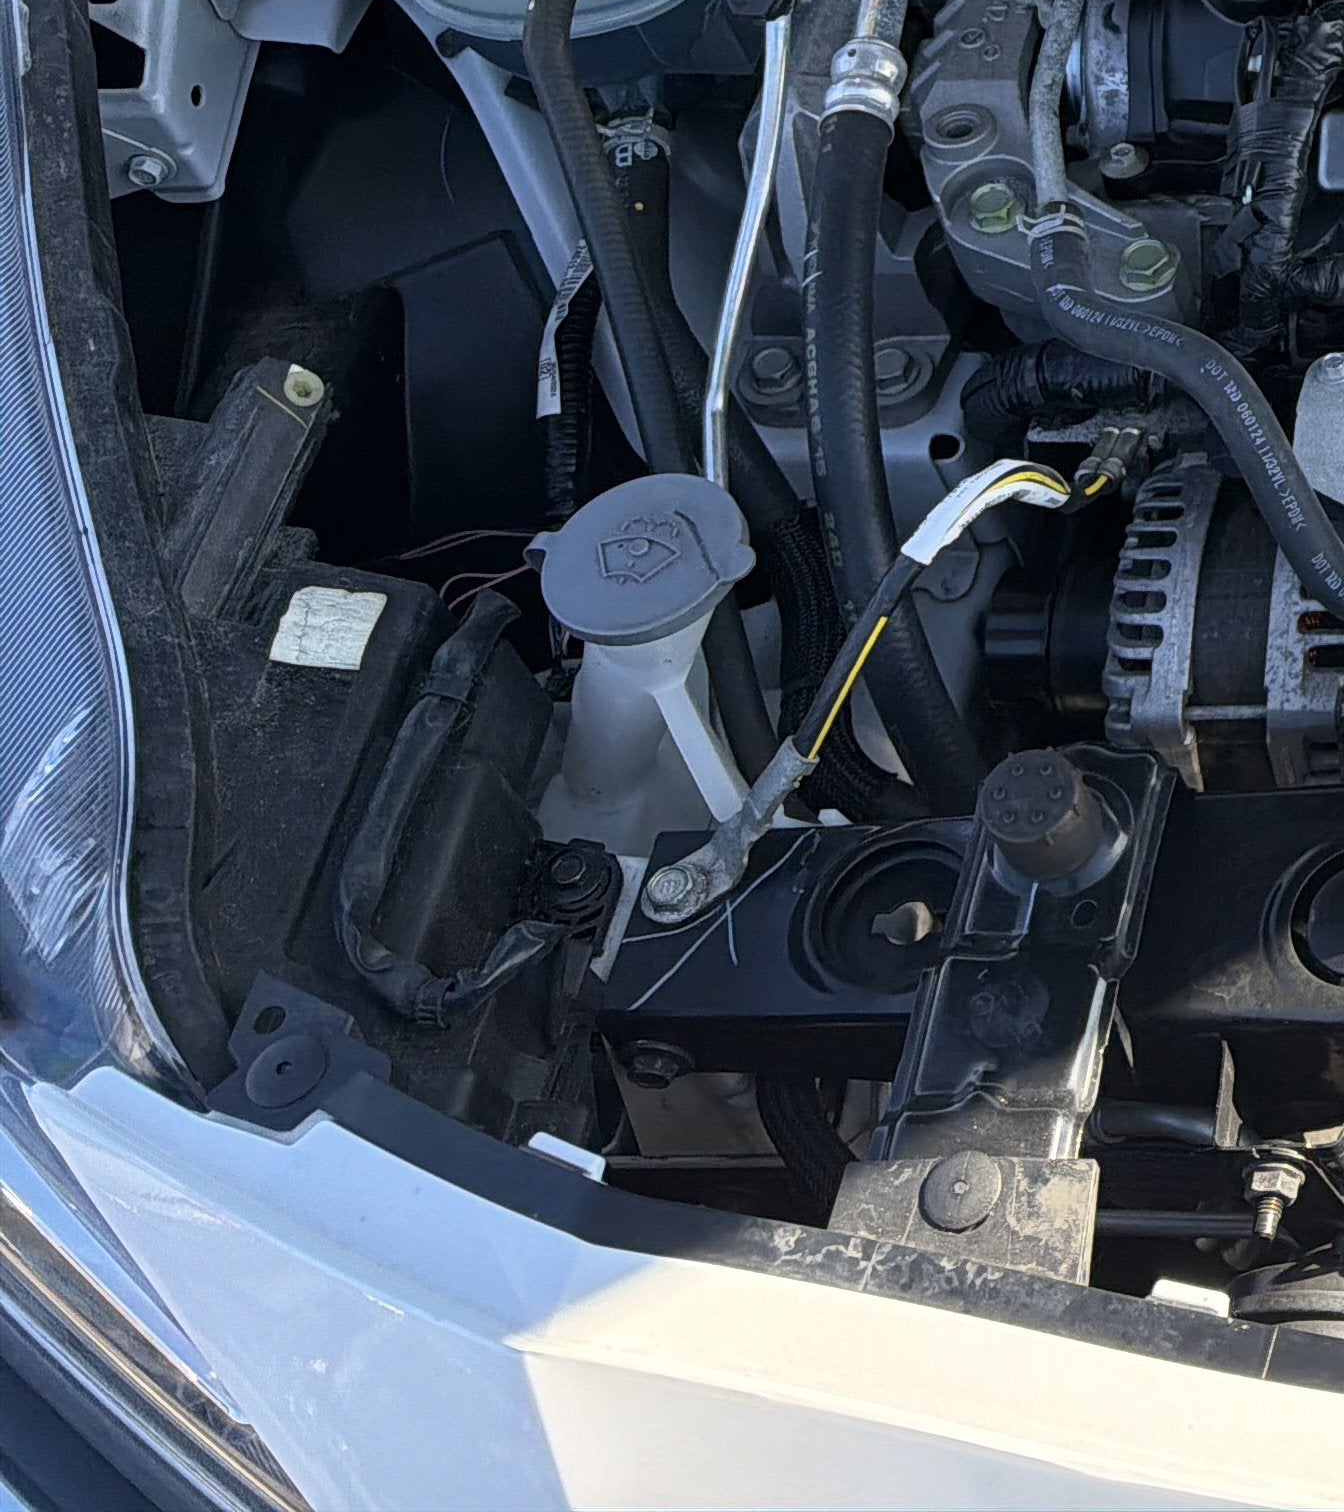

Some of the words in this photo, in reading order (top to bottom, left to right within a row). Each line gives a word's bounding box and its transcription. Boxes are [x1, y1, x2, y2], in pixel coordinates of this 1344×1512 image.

[615, 144, 633, 167] B
[1205, 359, 1229, 382] DOT
[1237, 402, 1266, 447] 060124
[1311, 551, 1332, 575] DOT
